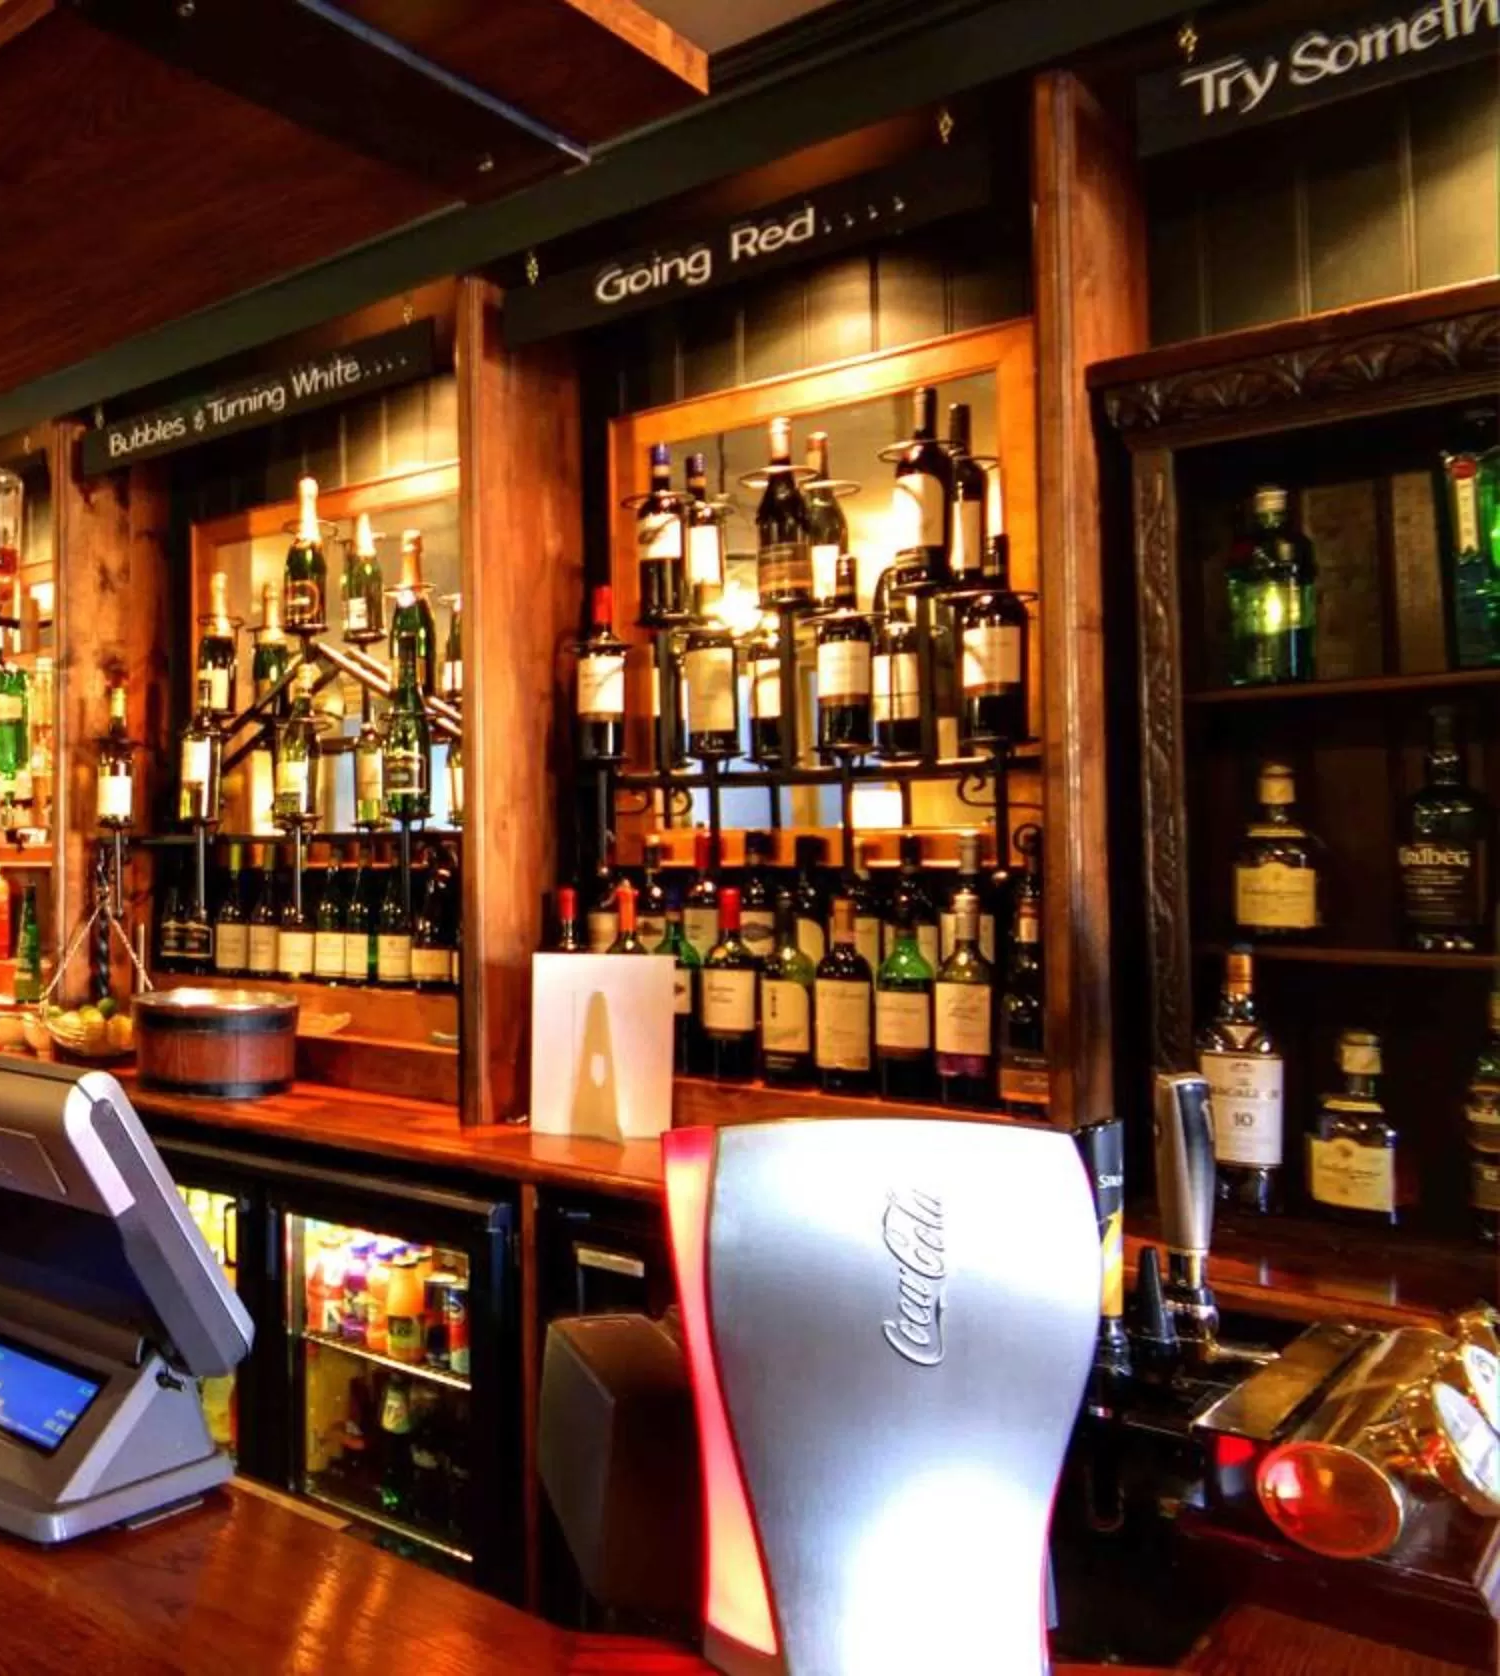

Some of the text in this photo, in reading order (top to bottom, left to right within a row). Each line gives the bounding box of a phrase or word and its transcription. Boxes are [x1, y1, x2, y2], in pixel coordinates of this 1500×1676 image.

[1181, 57, 1279, 115] Try
[595, 249, 713, 303] Going
[109, 416, 187, 457] Bubbles
[206, 387, 285, 424] Turning
[1232, 1111, 1255, 1127] 10
